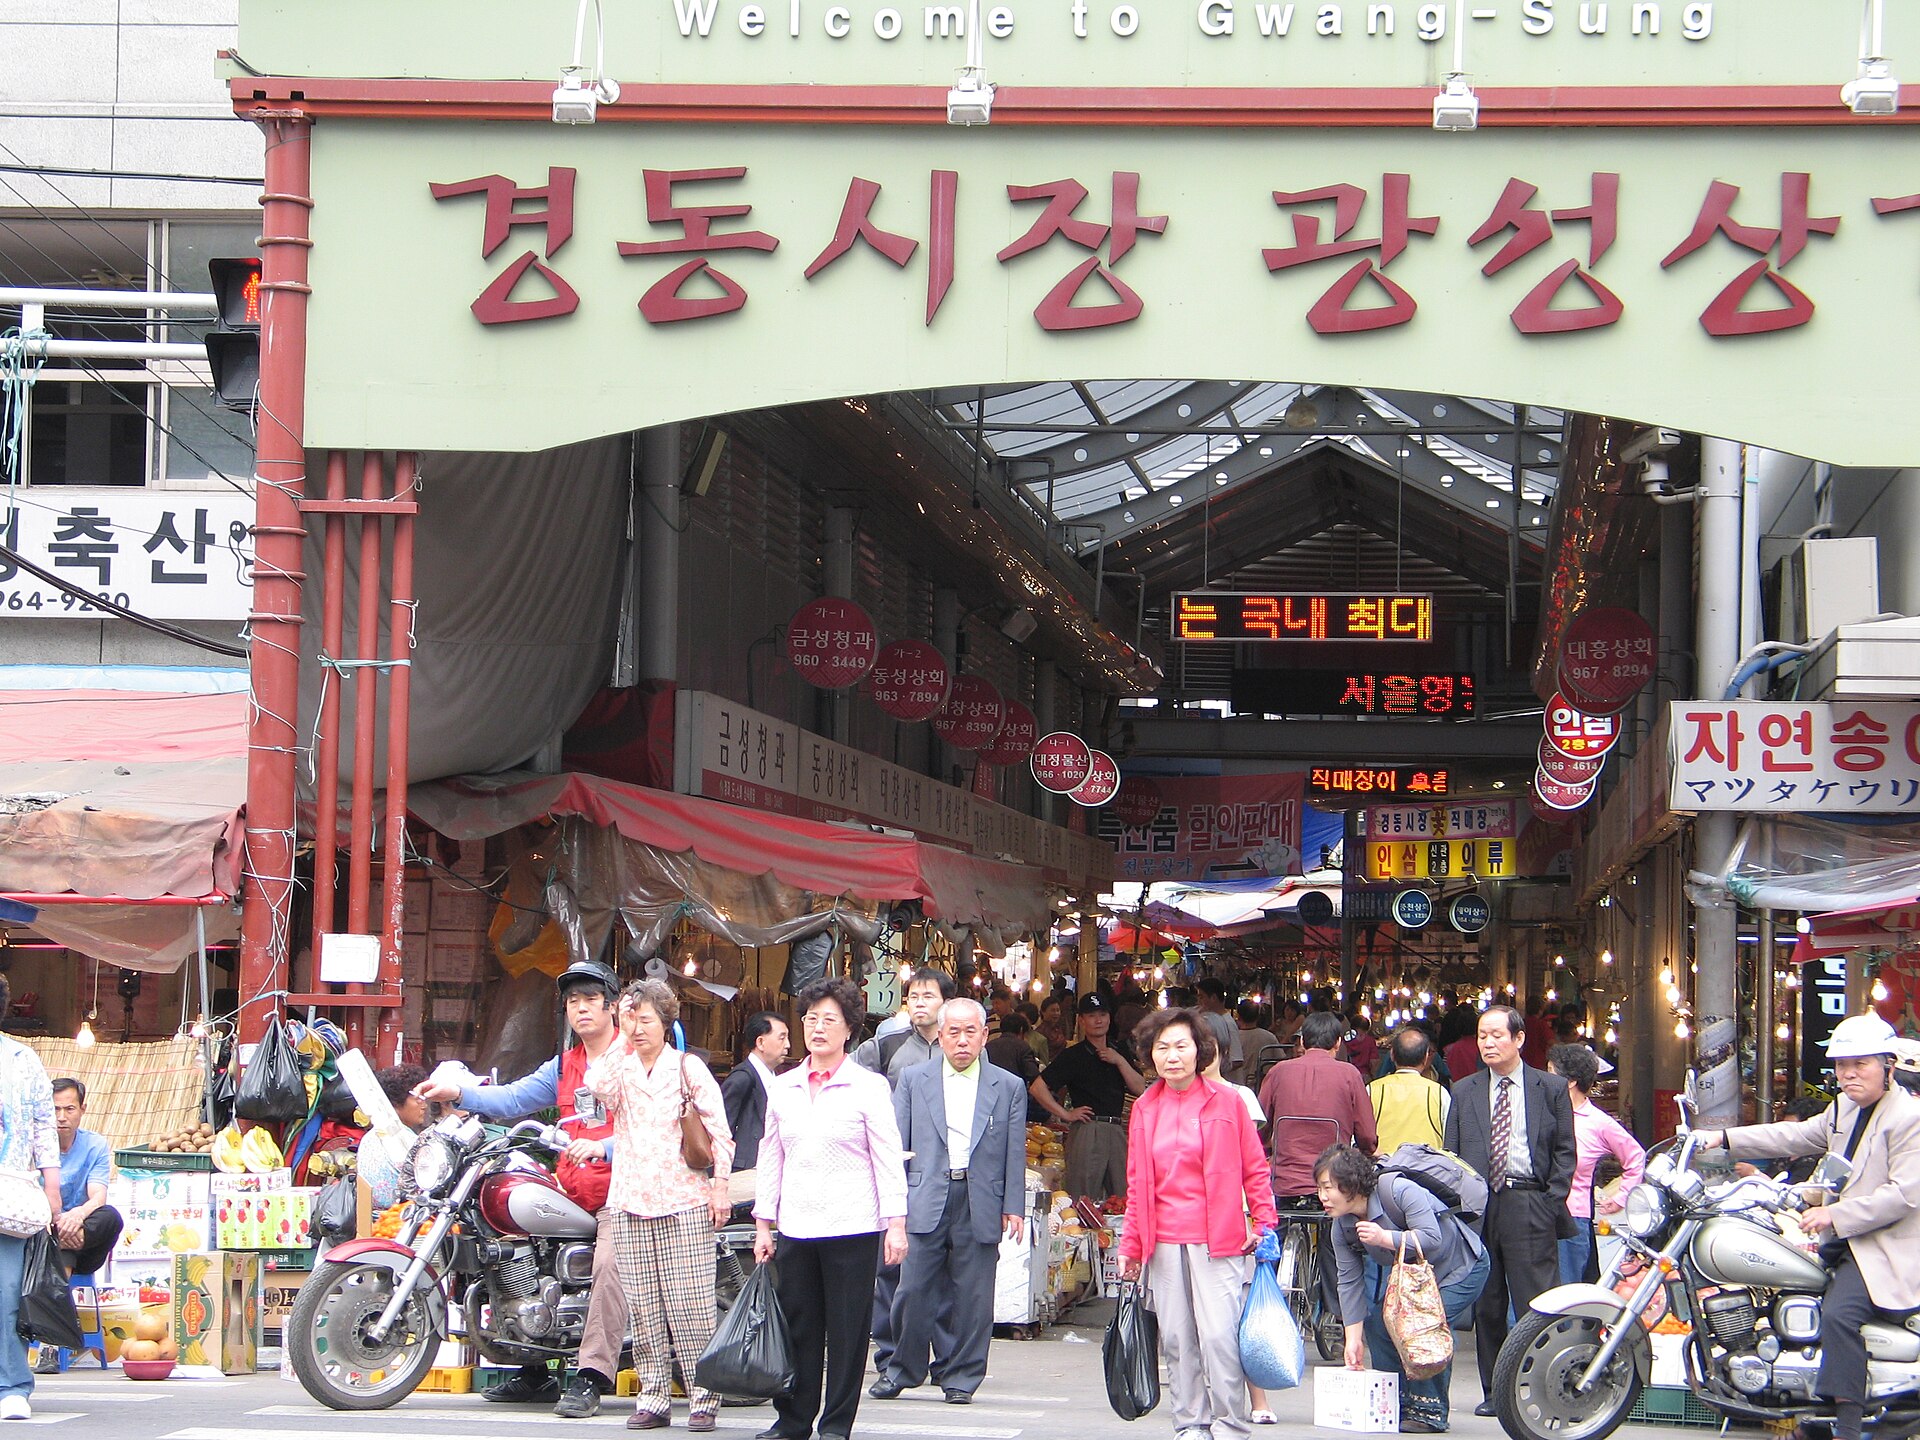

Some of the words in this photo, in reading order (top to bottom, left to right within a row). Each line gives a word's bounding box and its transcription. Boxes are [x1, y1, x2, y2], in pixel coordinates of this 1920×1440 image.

[674, 0, 1014, 40] Welcome
[1073, 0, 1140, 37] to
[1198, 0, 1715, 40] Gwang-Sung
[429, 166, 1169, 332] 경동시장
[1179, 597, 1217, 639] 는
[1242, 597, 1326, 639] 국내
[1348, 597, 1430, 639] 최대
[791, 629, 874, 650] 금성청과
[1567, 637, 1653, 660] 대흥상회
[872, 668, 945, 686] 동성상회
[718, 711, 786, 783] 금성청과
[1561, 738, 1585, 750] 2층
[1684, 710, 1920, 773] 자연송
[811, 744, 859, 802] 동성상회
[1034, 754, 1088, 767] 대정물산
[1311, 768, 1396, 791] 직매장이
[1684, 777, 1920, 806] マツタケウリ
[1187, 799, 1295, 852] 할인판매
[1381, 812, 1427, 833] 경동시장
[1123, 857, 1194, 876] 전문상가
[1377, 844, 1417, 876] 인삼
[1461, 841, 1504, 874] 의류
